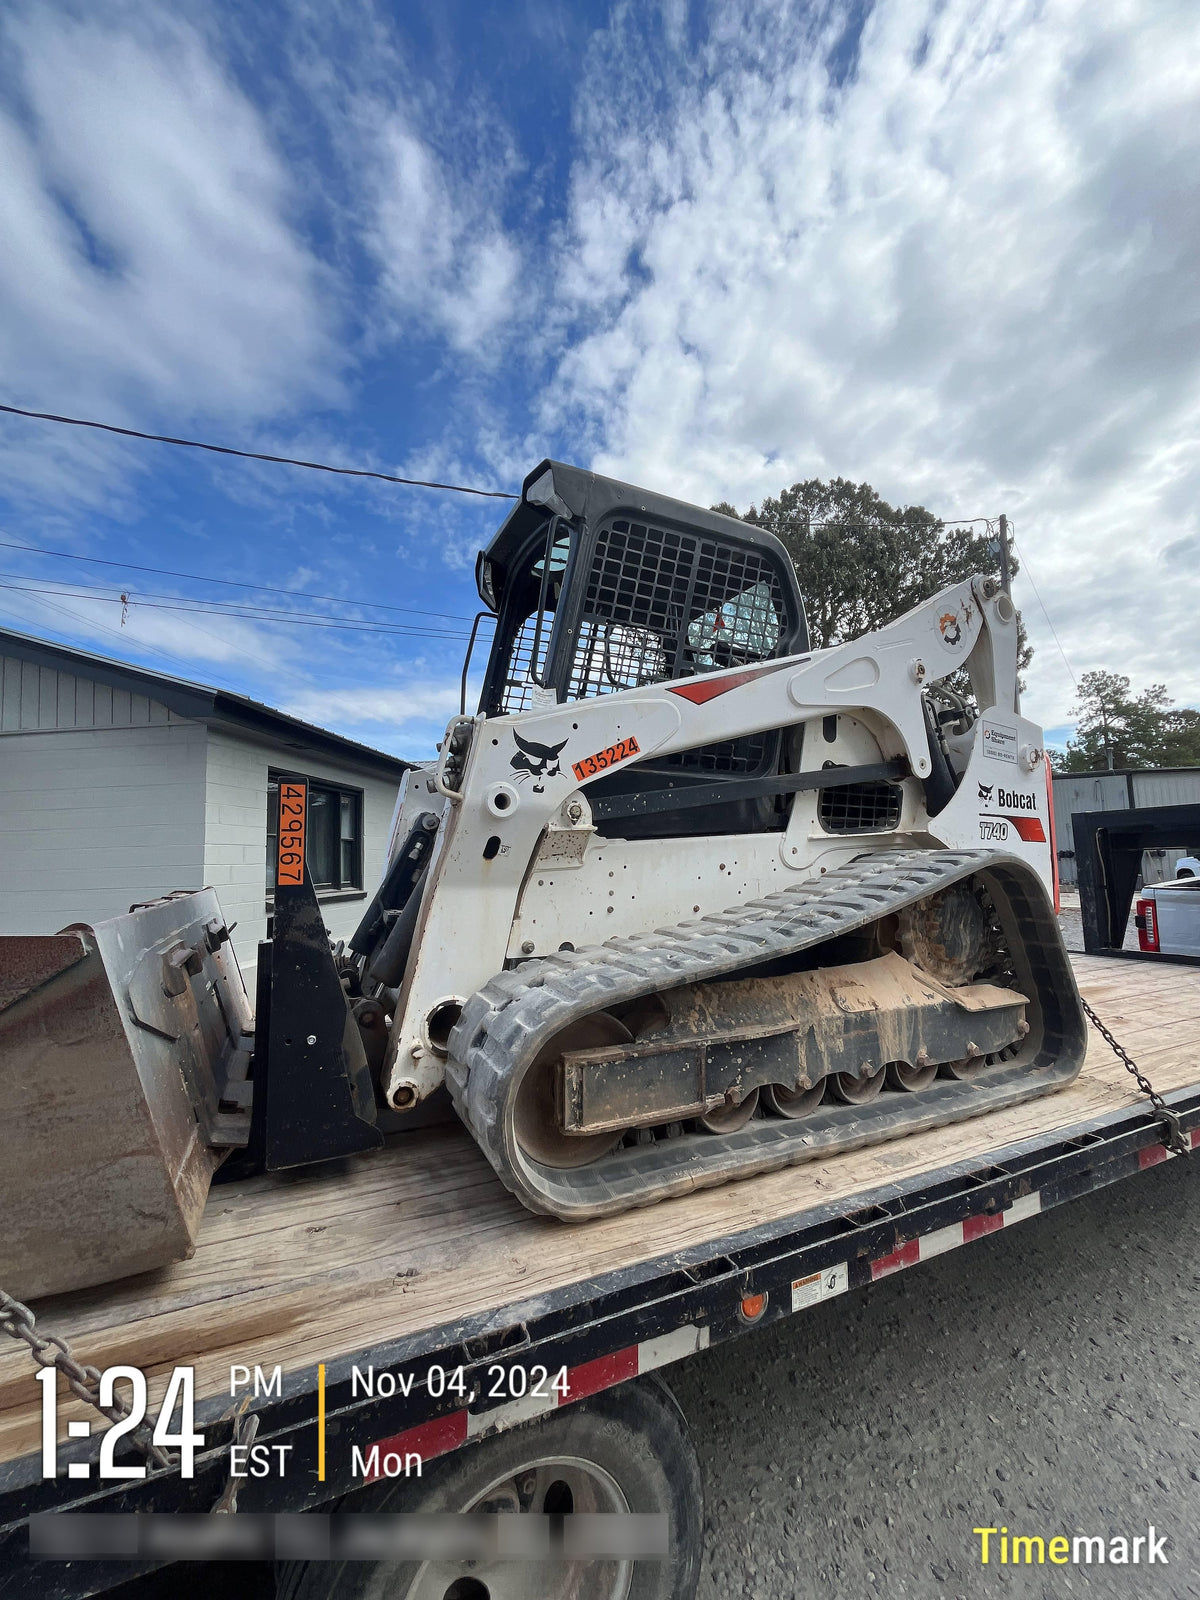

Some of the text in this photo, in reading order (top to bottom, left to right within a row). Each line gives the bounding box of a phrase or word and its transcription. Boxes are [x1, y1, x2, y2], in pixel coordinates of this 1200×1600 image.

[574, 737, 639, 778] 135224
[998, 788, 1036, 810] Bobcat
[280, 786, 303, 882] 429567
[979, 821, 1008, 841] T740
